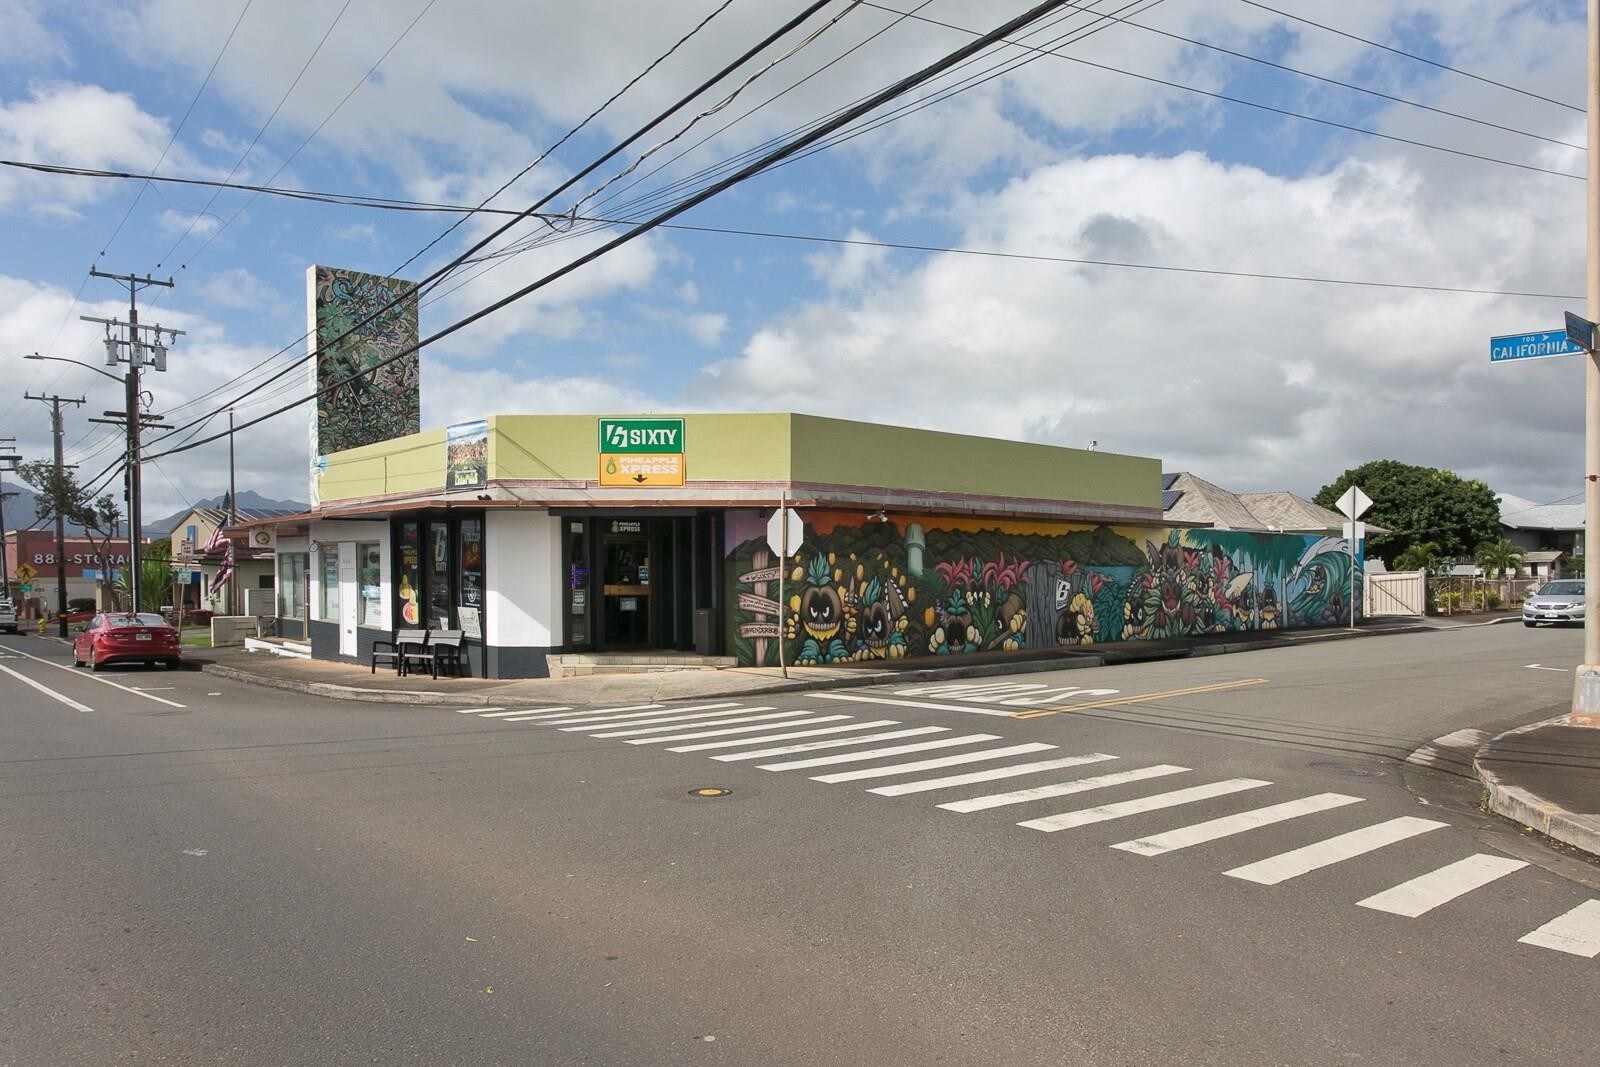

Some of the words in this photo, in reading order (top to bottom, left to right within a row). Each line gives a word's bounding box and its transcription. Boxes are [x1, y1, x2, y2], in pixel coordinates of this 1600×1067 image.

[1492, 341, 1568, 360] CALIFORNIA
[630, 429, 678, 445] SIXTY
[619, 456, 678, 465] PINEAPPLE
[619, 464, 679, 475] XPRESS
